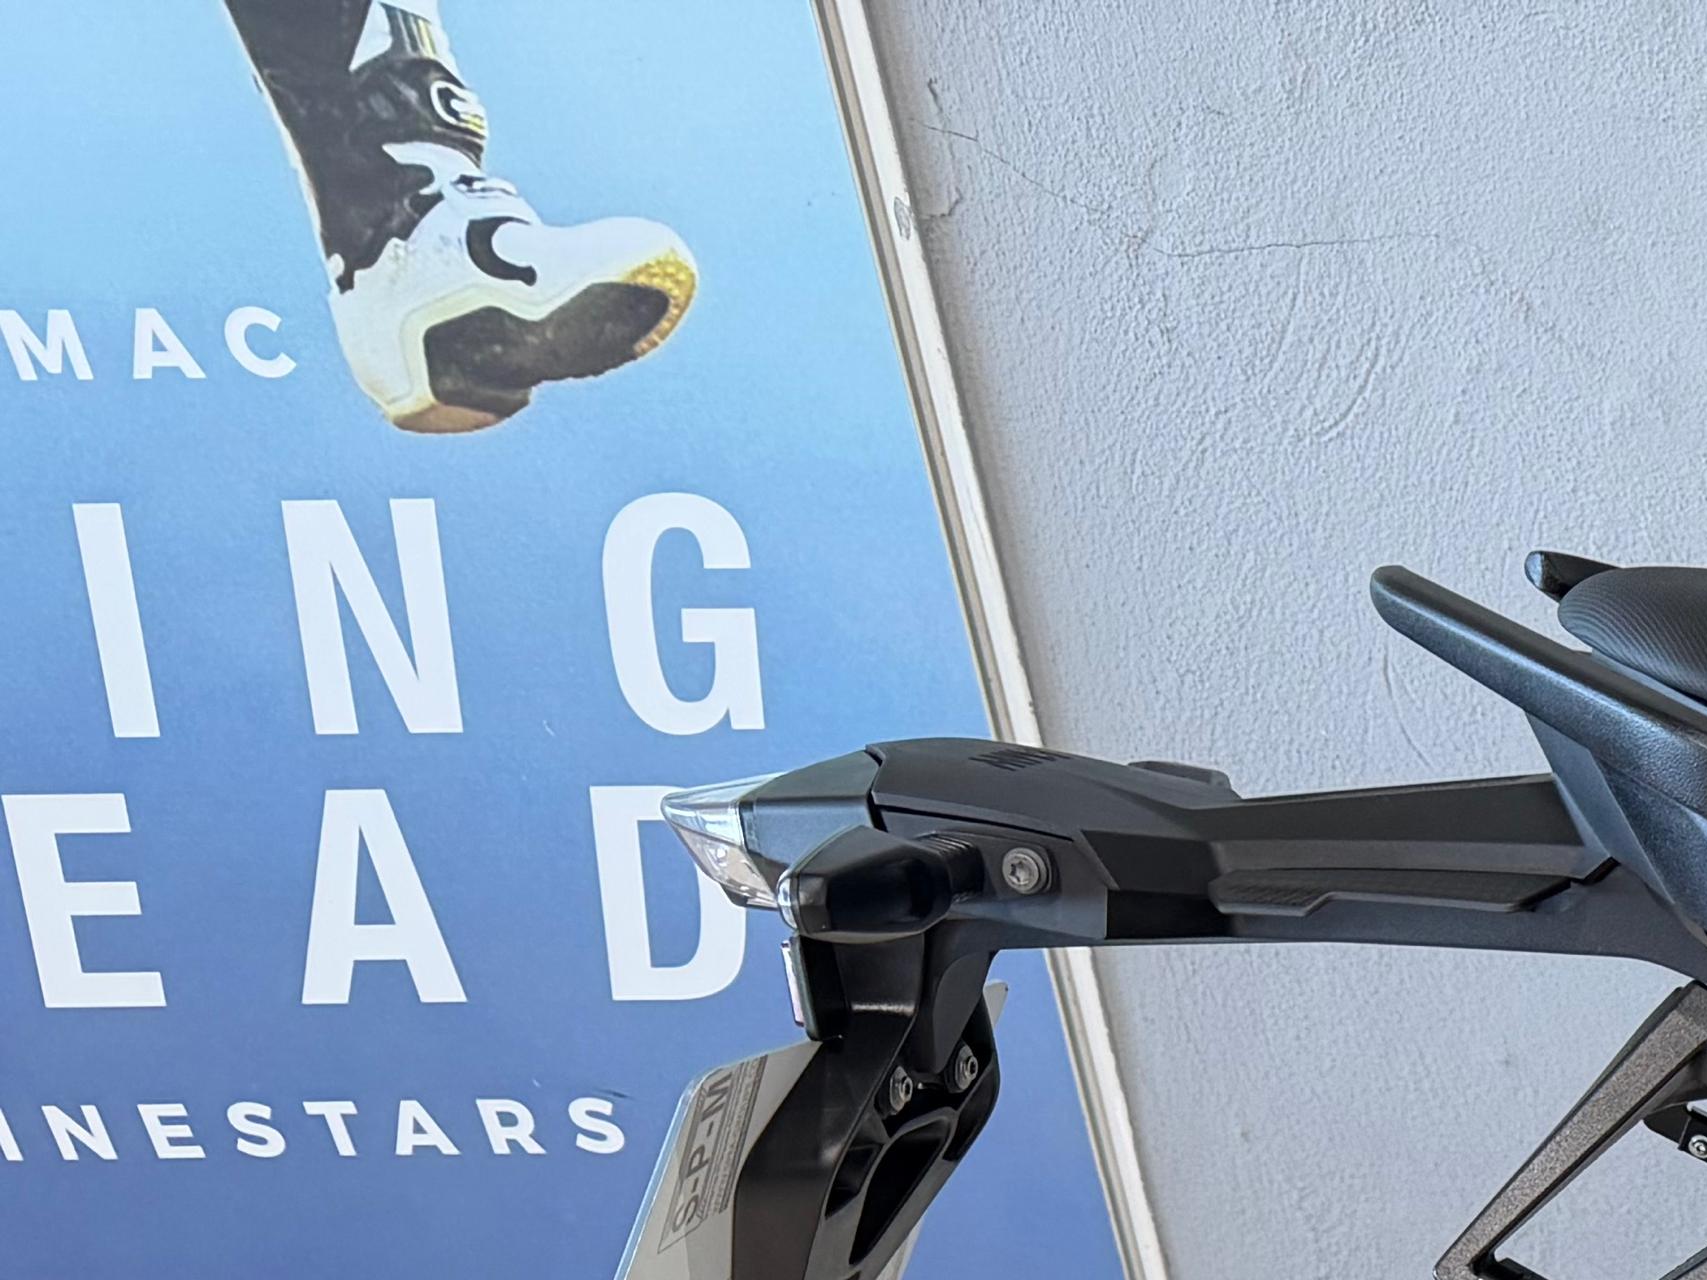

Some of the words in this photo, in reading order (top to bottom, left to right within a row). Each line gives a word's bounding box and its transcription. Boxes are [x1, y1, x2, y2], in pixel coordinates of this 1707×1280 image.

[0, 306, 297, 382] MAC
[72, 491, 766, 739] ING
[2, 785, 747, 1008] EAD
